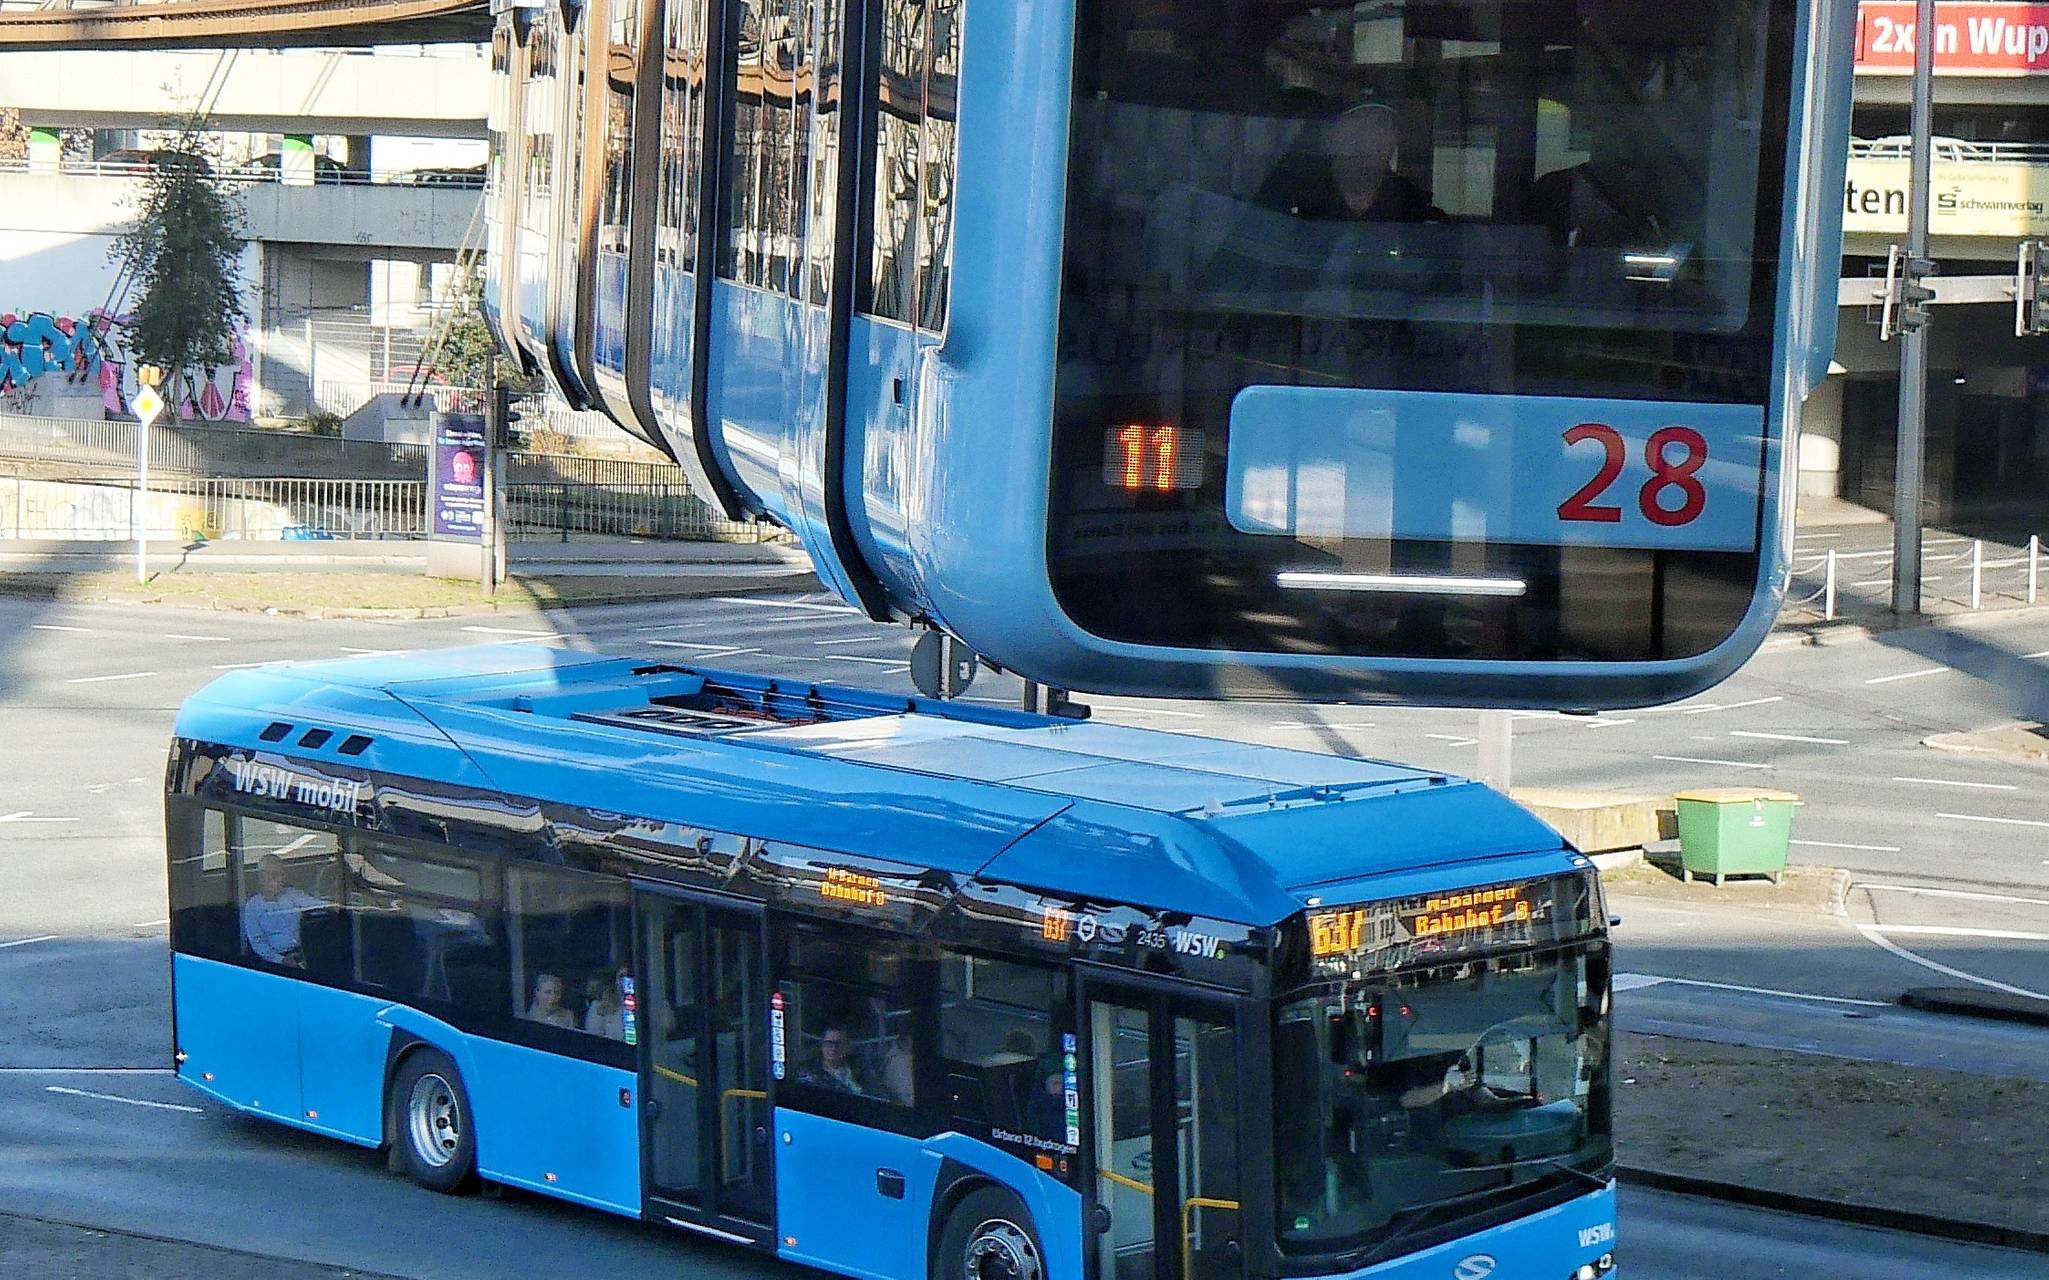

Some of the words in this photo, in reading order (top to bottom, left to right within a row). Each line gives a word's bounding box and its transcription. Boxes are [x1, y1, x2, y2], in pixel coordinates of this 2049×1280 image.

[1968, 17, 2049, 62] Wup
[1118, 424, 1176, 490] 11
[1559, 423, 1708, 526] 28
[235, 761, 293, 799] WSW
[297, 778, 359, 813] mobil
[1136, 930, 1167, 949] 2435
